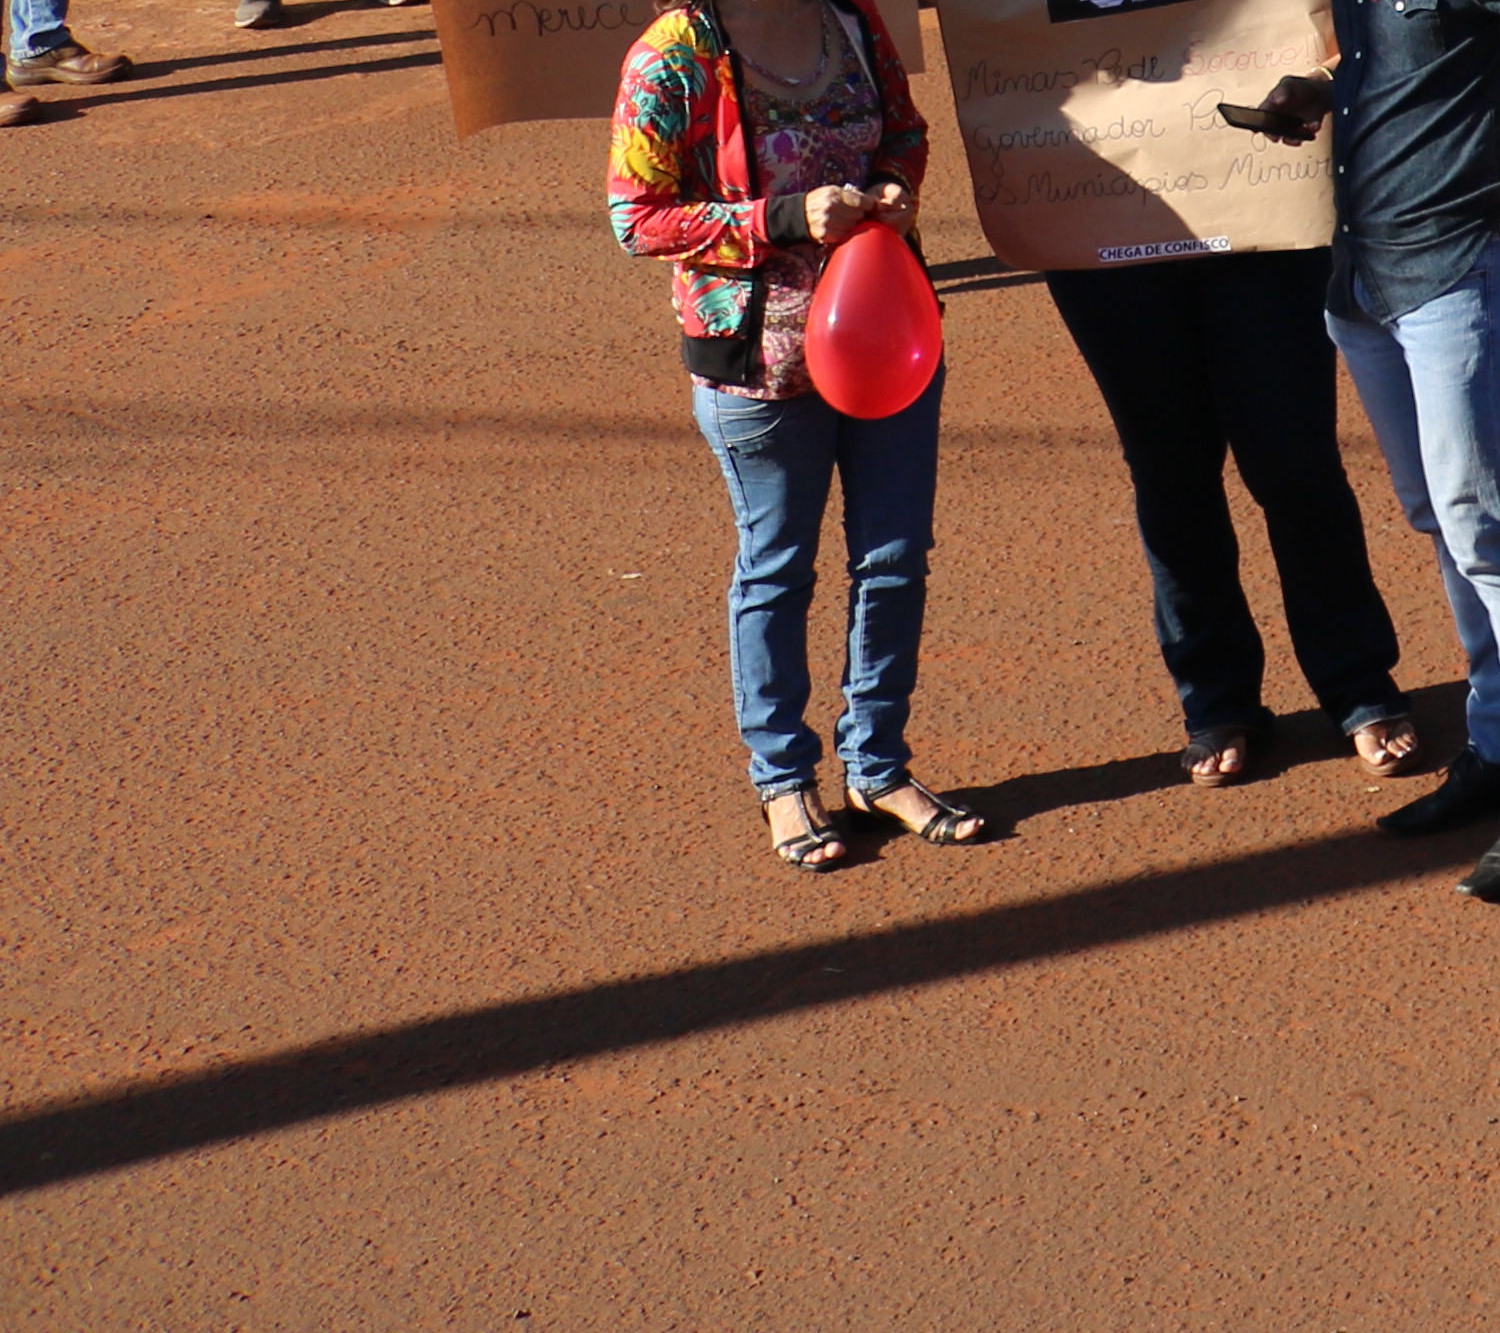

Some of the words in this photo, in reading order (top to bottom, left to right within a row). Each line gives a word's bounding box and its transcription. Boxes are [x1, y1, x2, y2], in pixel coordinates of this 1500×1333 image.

[1100, 244, 1142, 261] CHEGA
[1145, 244, 1163, 257] DE
[1165, 238, 1229, 256] CONFISCO
